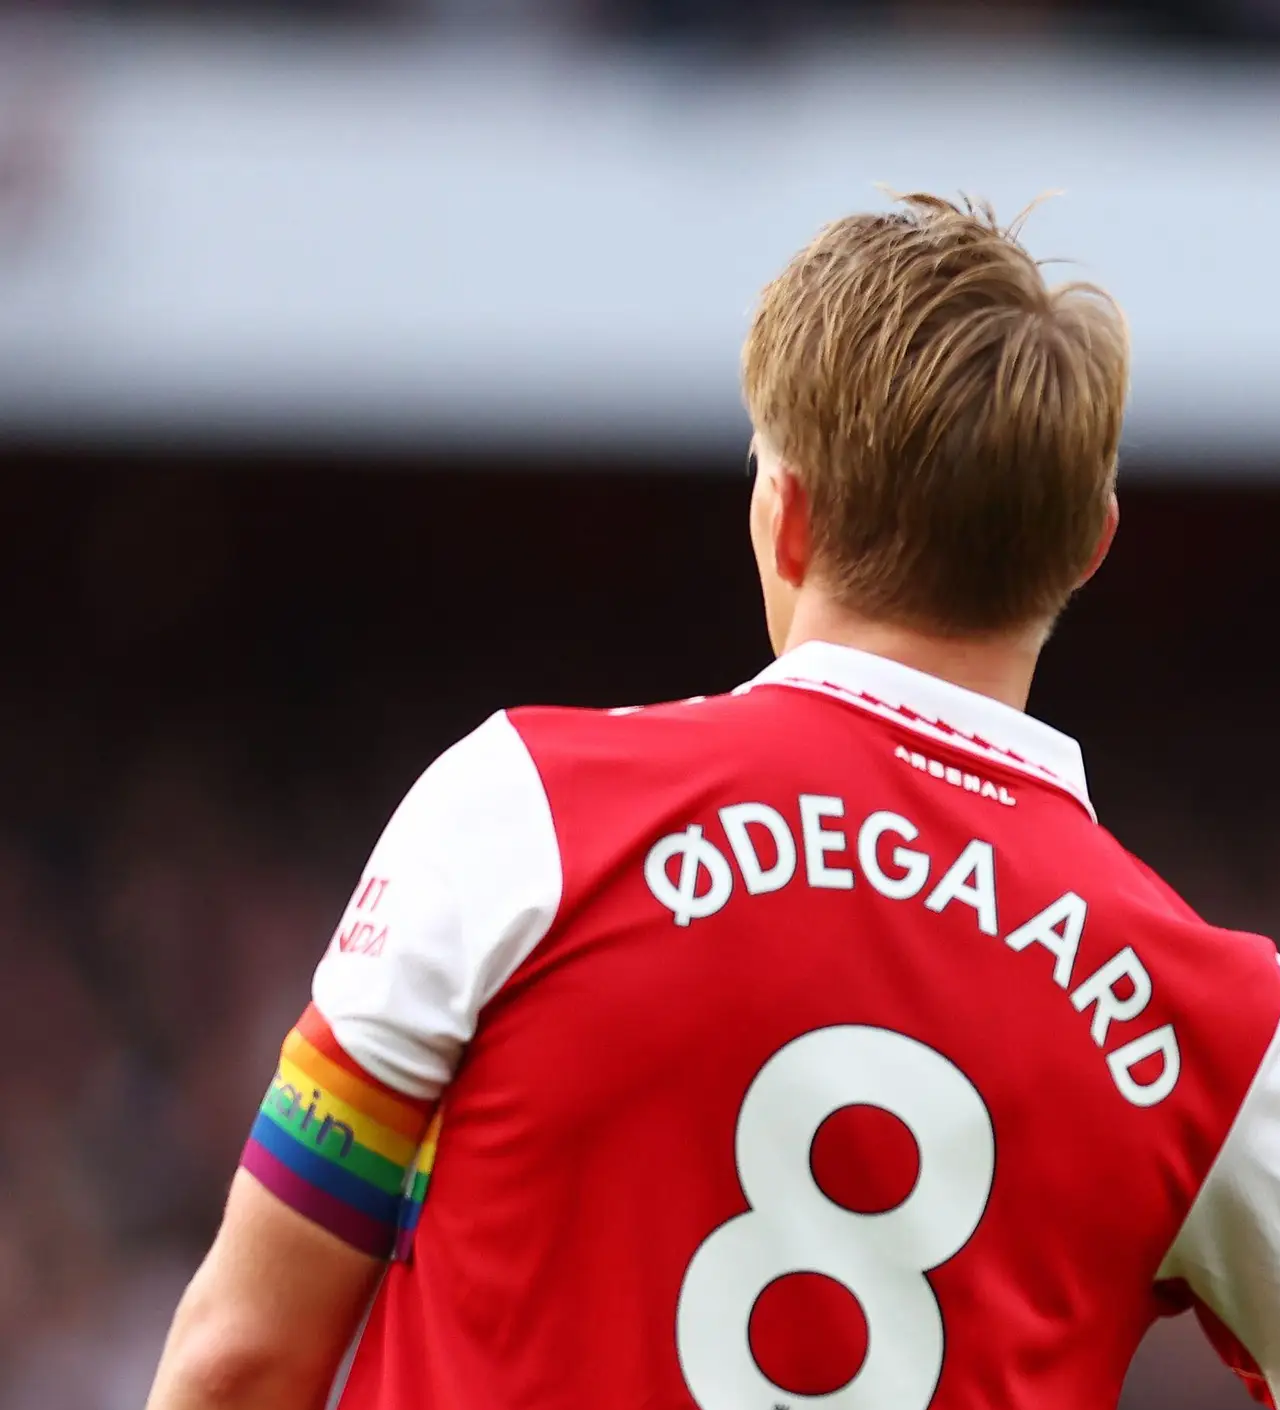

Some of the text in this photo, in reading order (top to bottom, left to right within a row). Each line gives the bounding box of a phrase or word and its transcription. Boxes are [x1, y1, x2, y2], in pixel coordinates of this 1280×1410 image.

[894, 745, 1016, 806] ARSENAL
[644, 793, 1181, 1108] ØDEGAARD
[275, 1074, 354, 1159] ain
